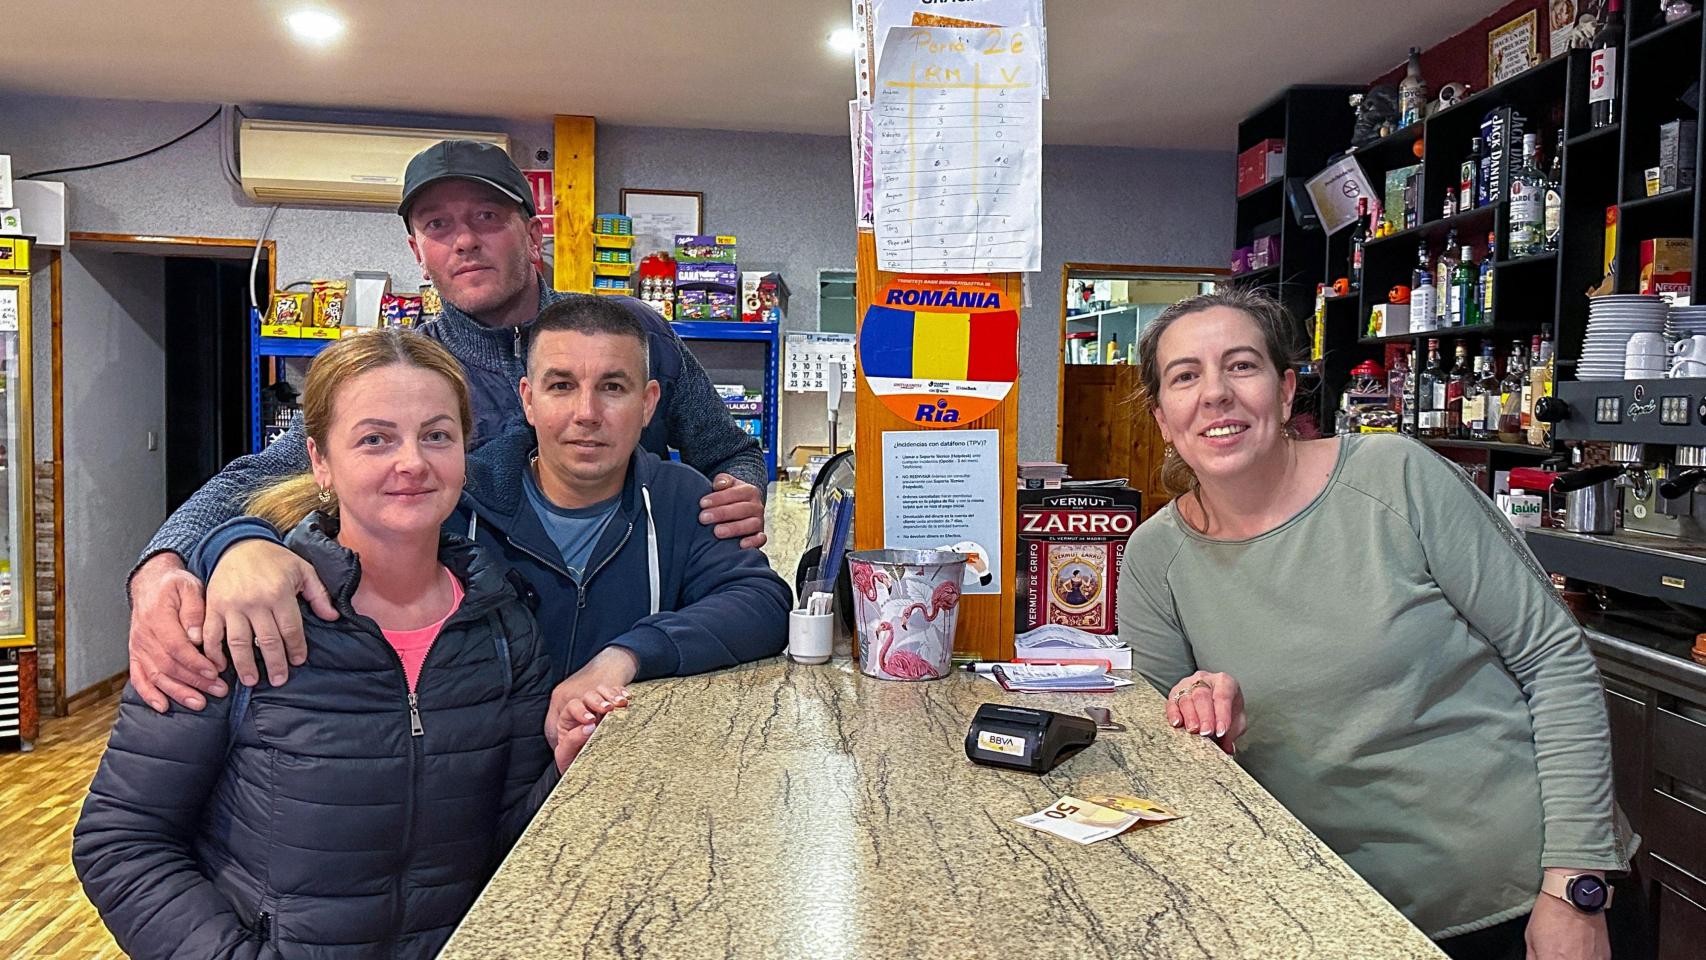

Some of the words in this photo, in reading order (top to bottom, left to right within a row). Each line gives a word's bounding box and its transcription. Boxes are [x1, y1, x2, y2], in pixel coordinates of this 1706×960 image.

[1591, 54, 1604, 90] 5
[1491, 116, 1503, 148] JACK
[886, 287, 1000, 308] ROMÂNIA
[915, 398, 959, 422] Ria
[1050, 498, 1106, 506] VERMUT
[1512, 503, 1540, 513] Lauki
[1023, 513, 1134, 533] ZARRO
[1030, 543, 1039, 571] GRIFO
[1031, 575, 1038, 586] DE
[1029, 588, 1038, 626] VERMUT
[990, 735, 1014, 746] BBVA
[1045, 802, 1080, 820] 50
